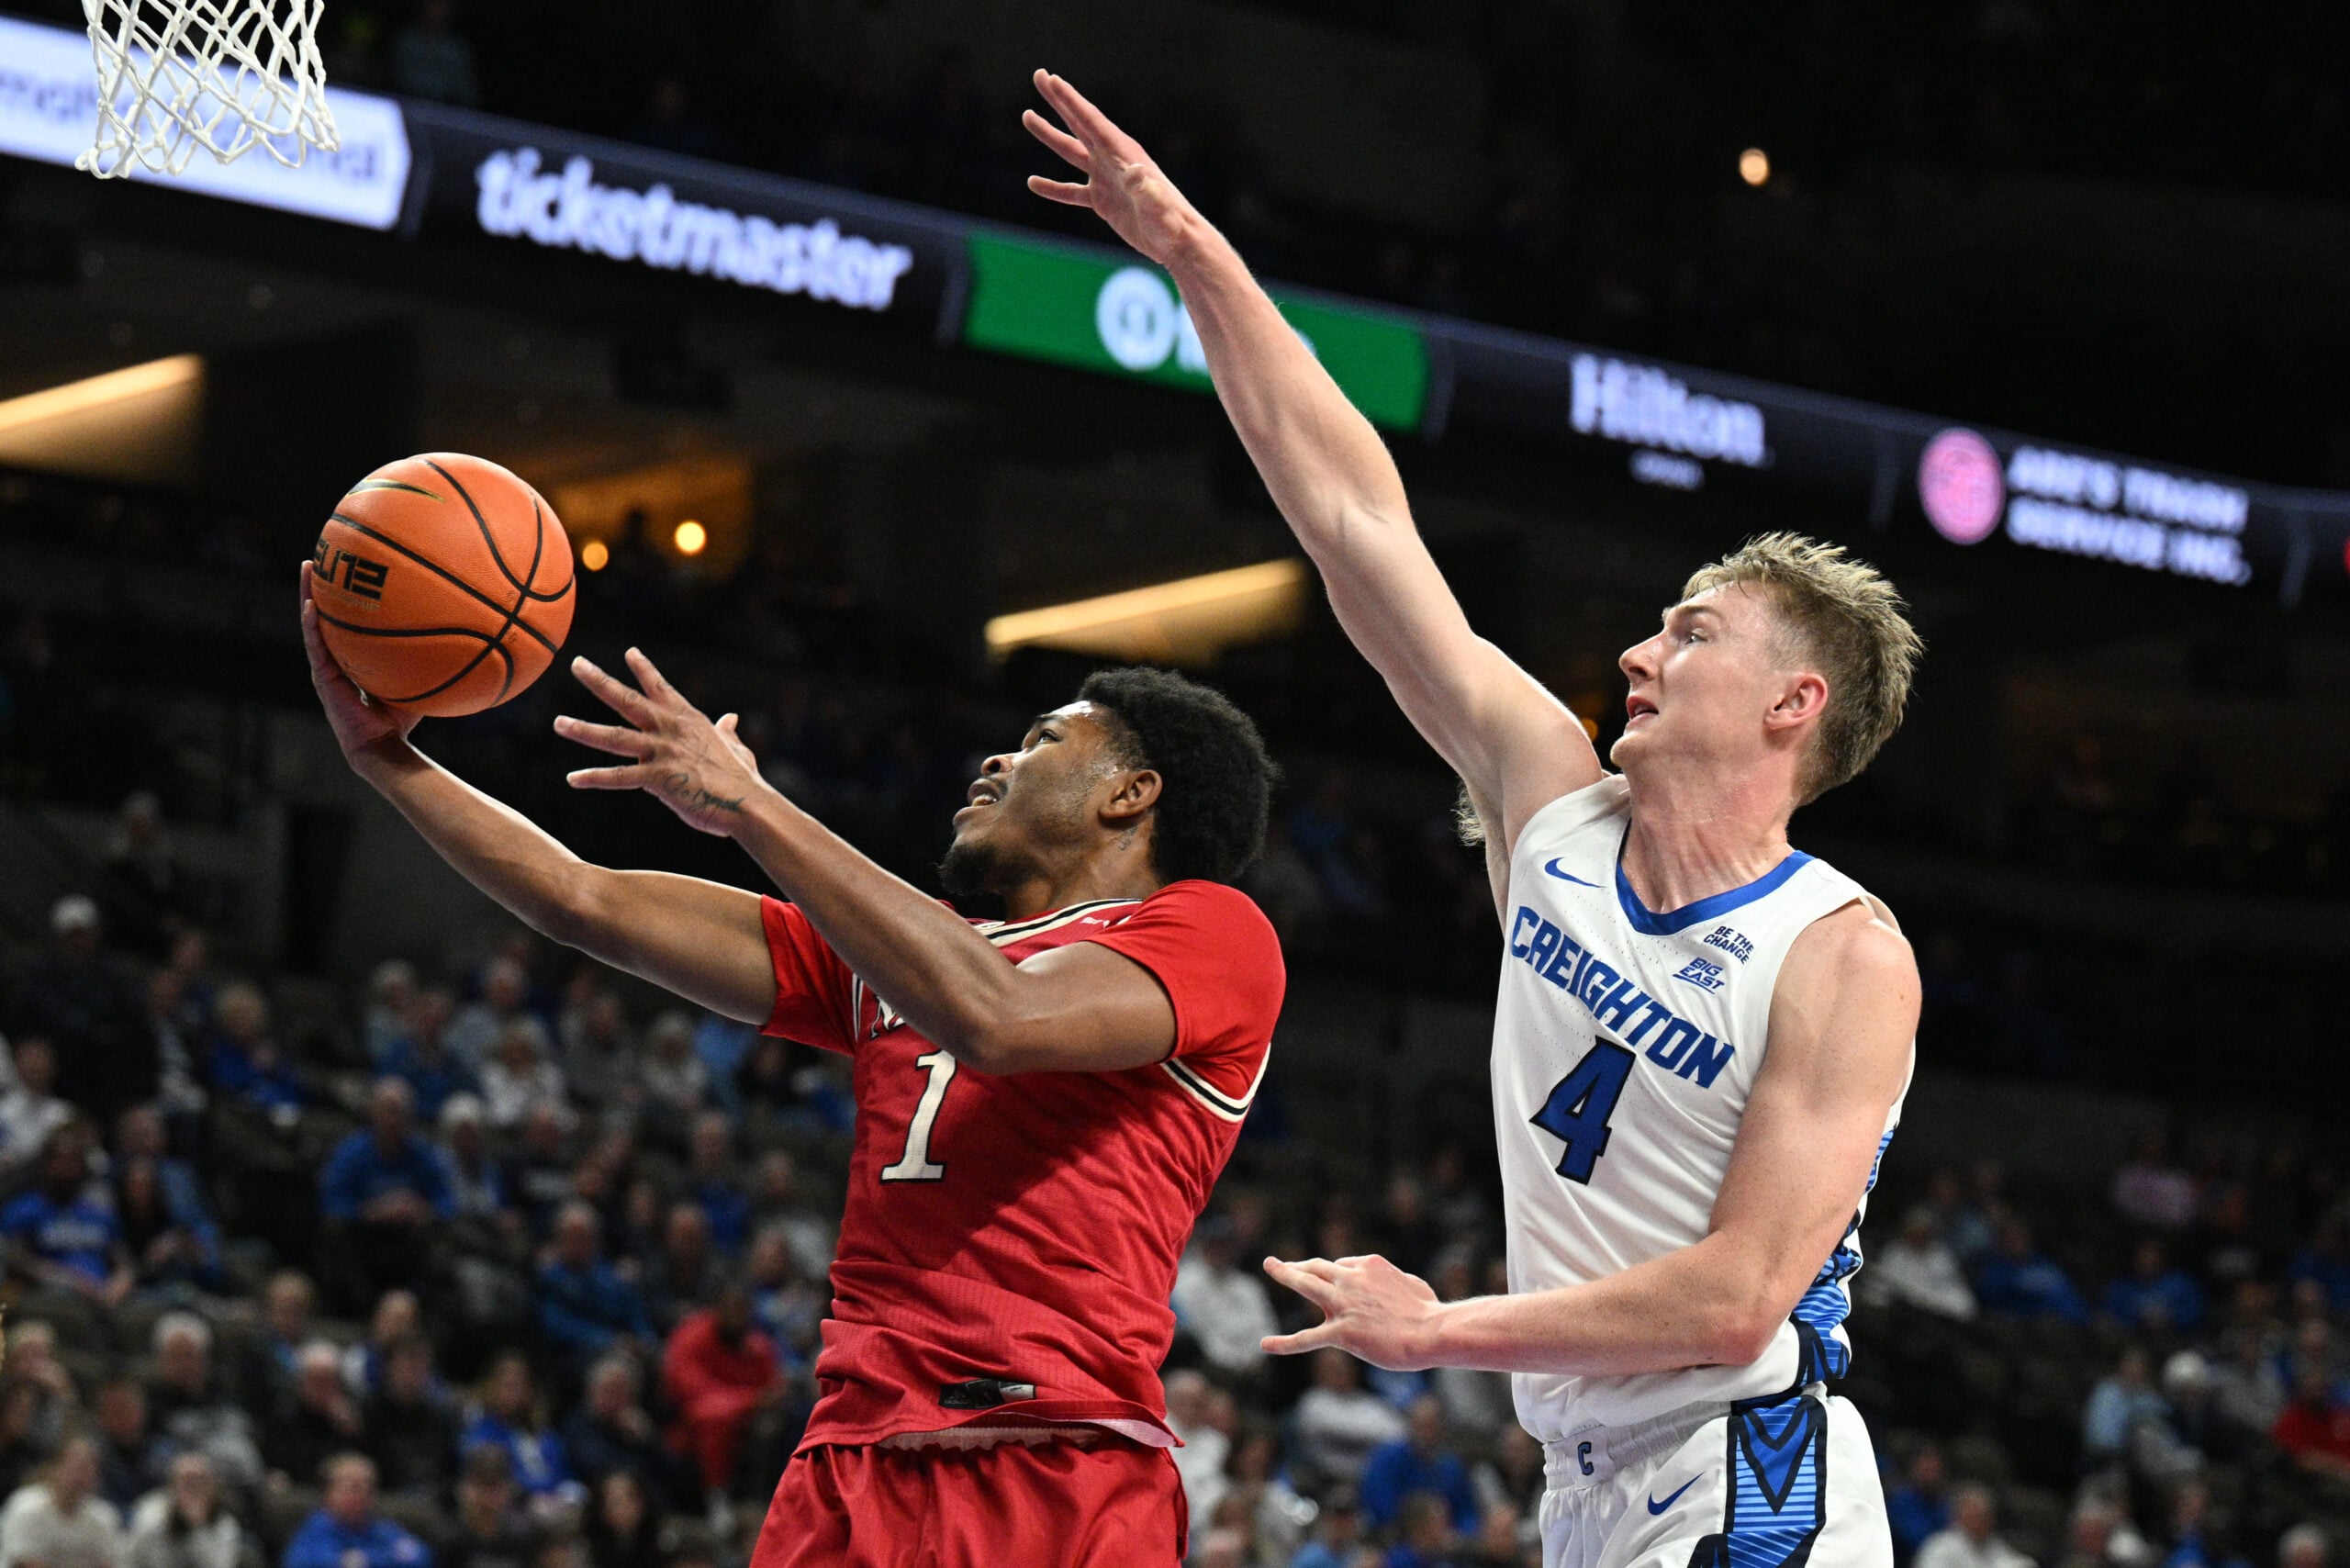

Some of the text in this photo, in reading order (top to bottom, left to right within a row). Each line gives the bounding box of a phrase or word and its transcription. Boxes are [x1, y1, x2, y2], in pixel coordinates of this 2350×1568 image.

[476, 147, 913, 310] ticketmaster
[1571, 353, 1765, 469] Hilton
[1689, 957, 1724, 977] BIG
[1703, 934, 1750, 965] CHANGE
[1714, 925, 1754, 955] BE THE
[1511, 905, 1735, 1090] CREIGHTON
[1679, 966, 1725, 990] EAST
[879, 1049, 958, 1183] 1
[1528, 1035, 1637, 1186] 4
[1577, 1441, 1595, 1476] C
